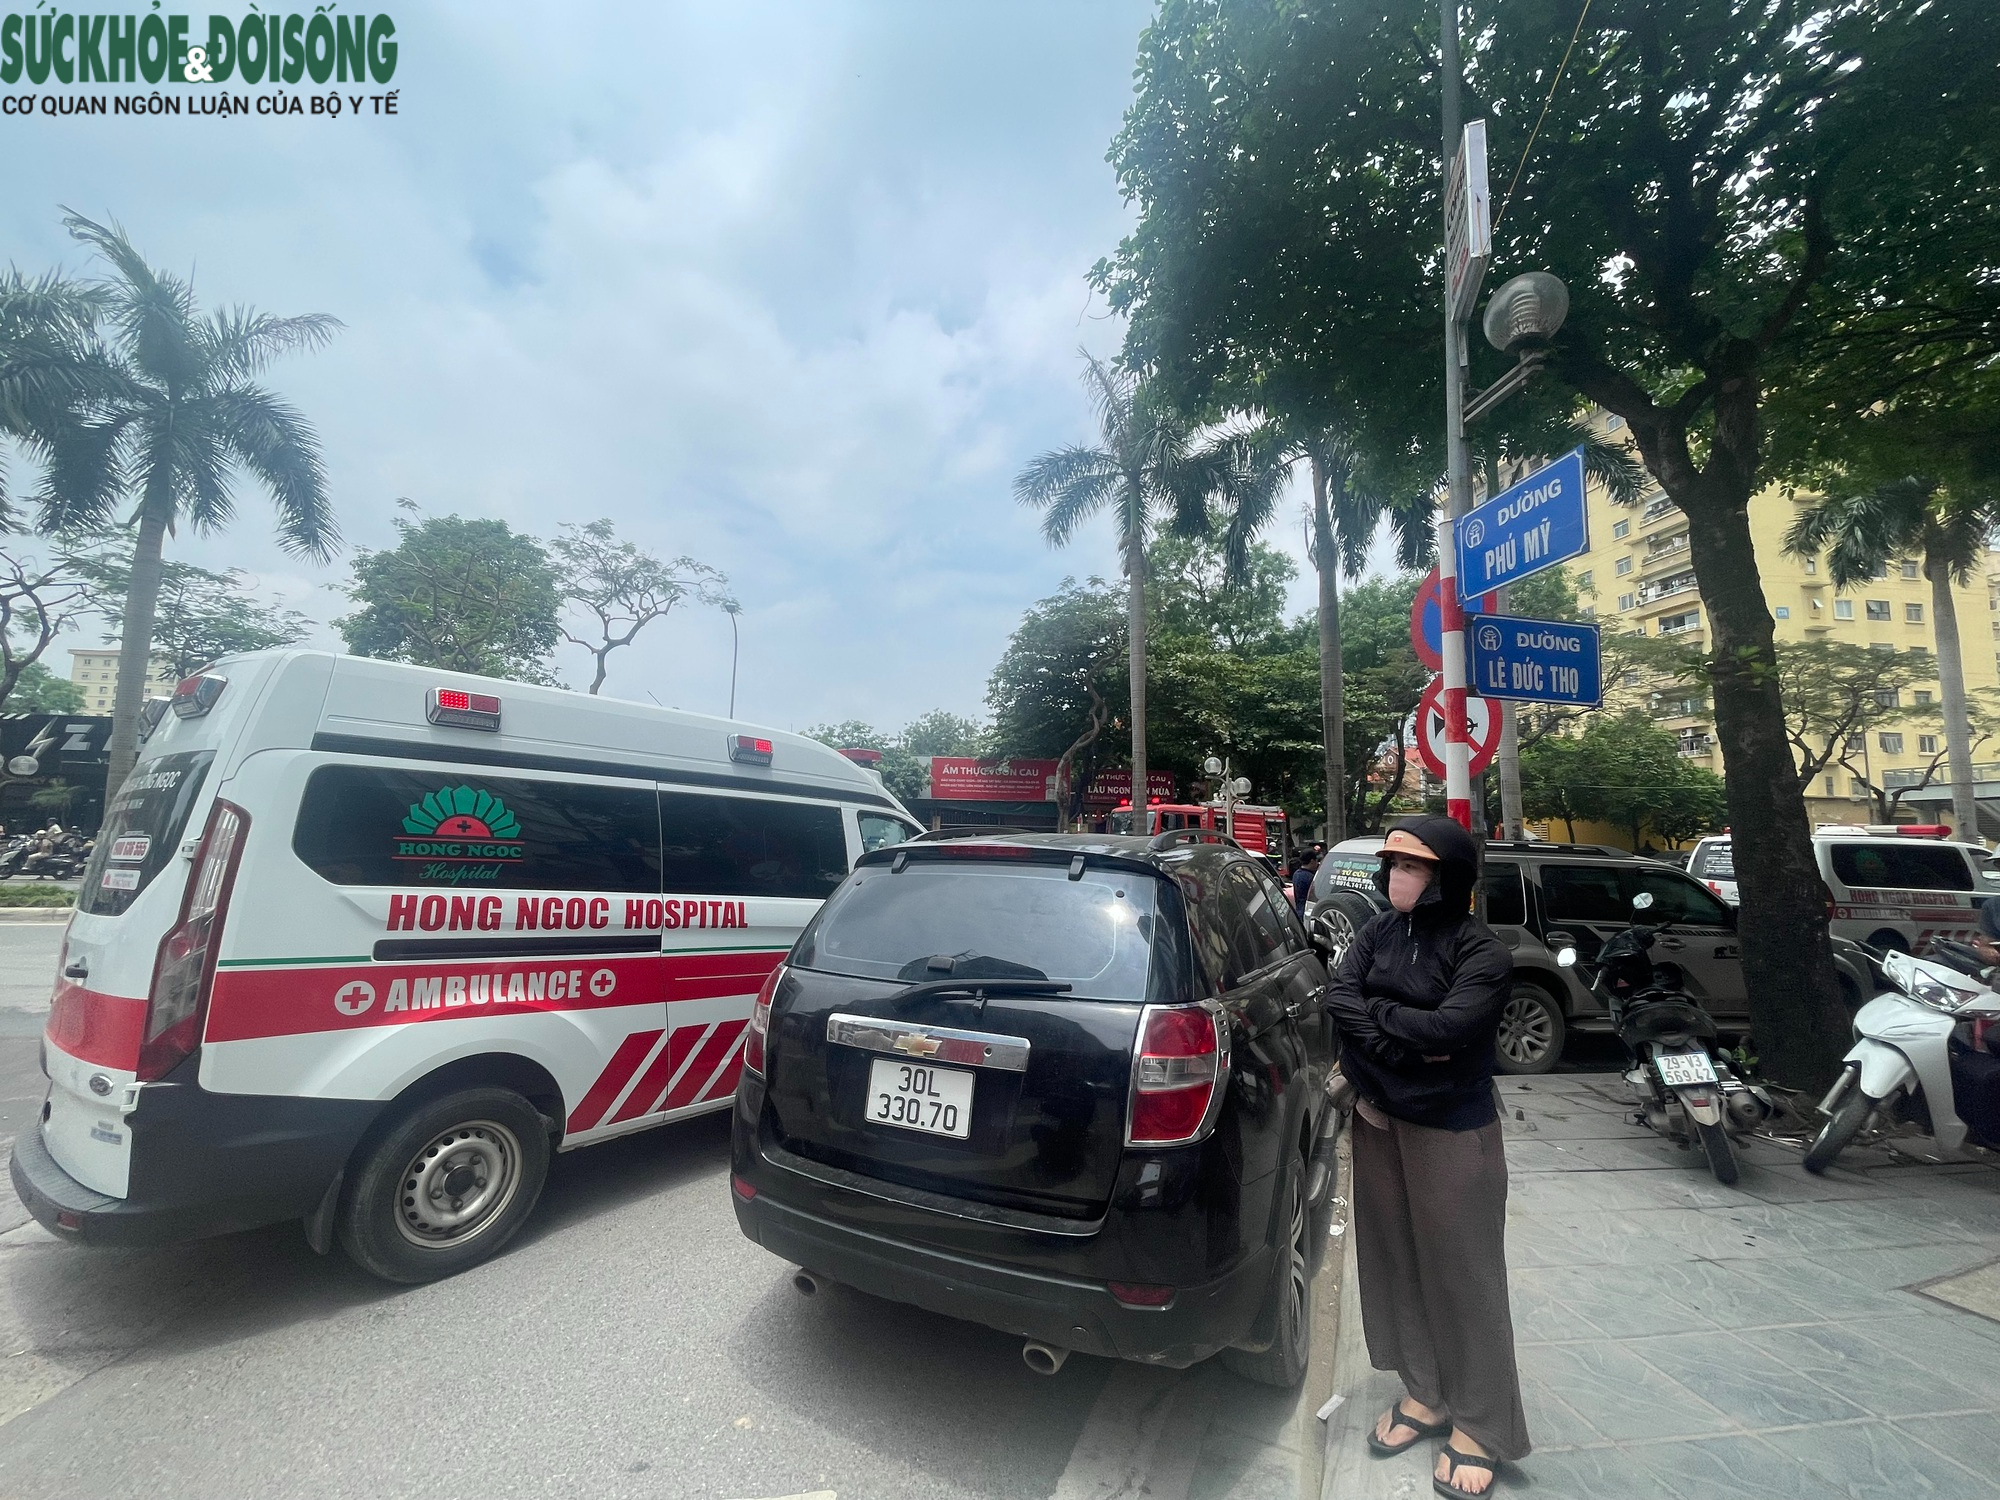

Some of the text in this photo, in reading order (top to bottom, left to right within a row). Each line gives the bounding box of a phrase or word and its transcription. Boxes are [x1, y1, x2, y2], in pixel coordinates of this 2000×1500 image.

[1497, 478, 1562, 527] ĐƯỜNG
[1485, 518, 1551, 581] PHÚ MỸ
[1516, 631, 1581, 652] ĐƯỜNG
[1488, 656, 1579, 699] LÊ ĐỨC THỌ
[1019, 768, 1039, 777] CAU
[1107, 786, 1131, 795] NGON
[400, 842, 522, 858] HONG NGOC
[418, 862, 503, 885] Hospital
[386, 894, 748, 932] HONG NGOC HOSPITAL
[384, 969, 582, 1012] AMBULANCE
[1664, 1055, 1703, 1070] 29-V3
[1665, 1068, 1714, 1084] 569.42
[898, 1066, 941, 1097] 30L
[877, 1093, 958, 1131] 330.70
